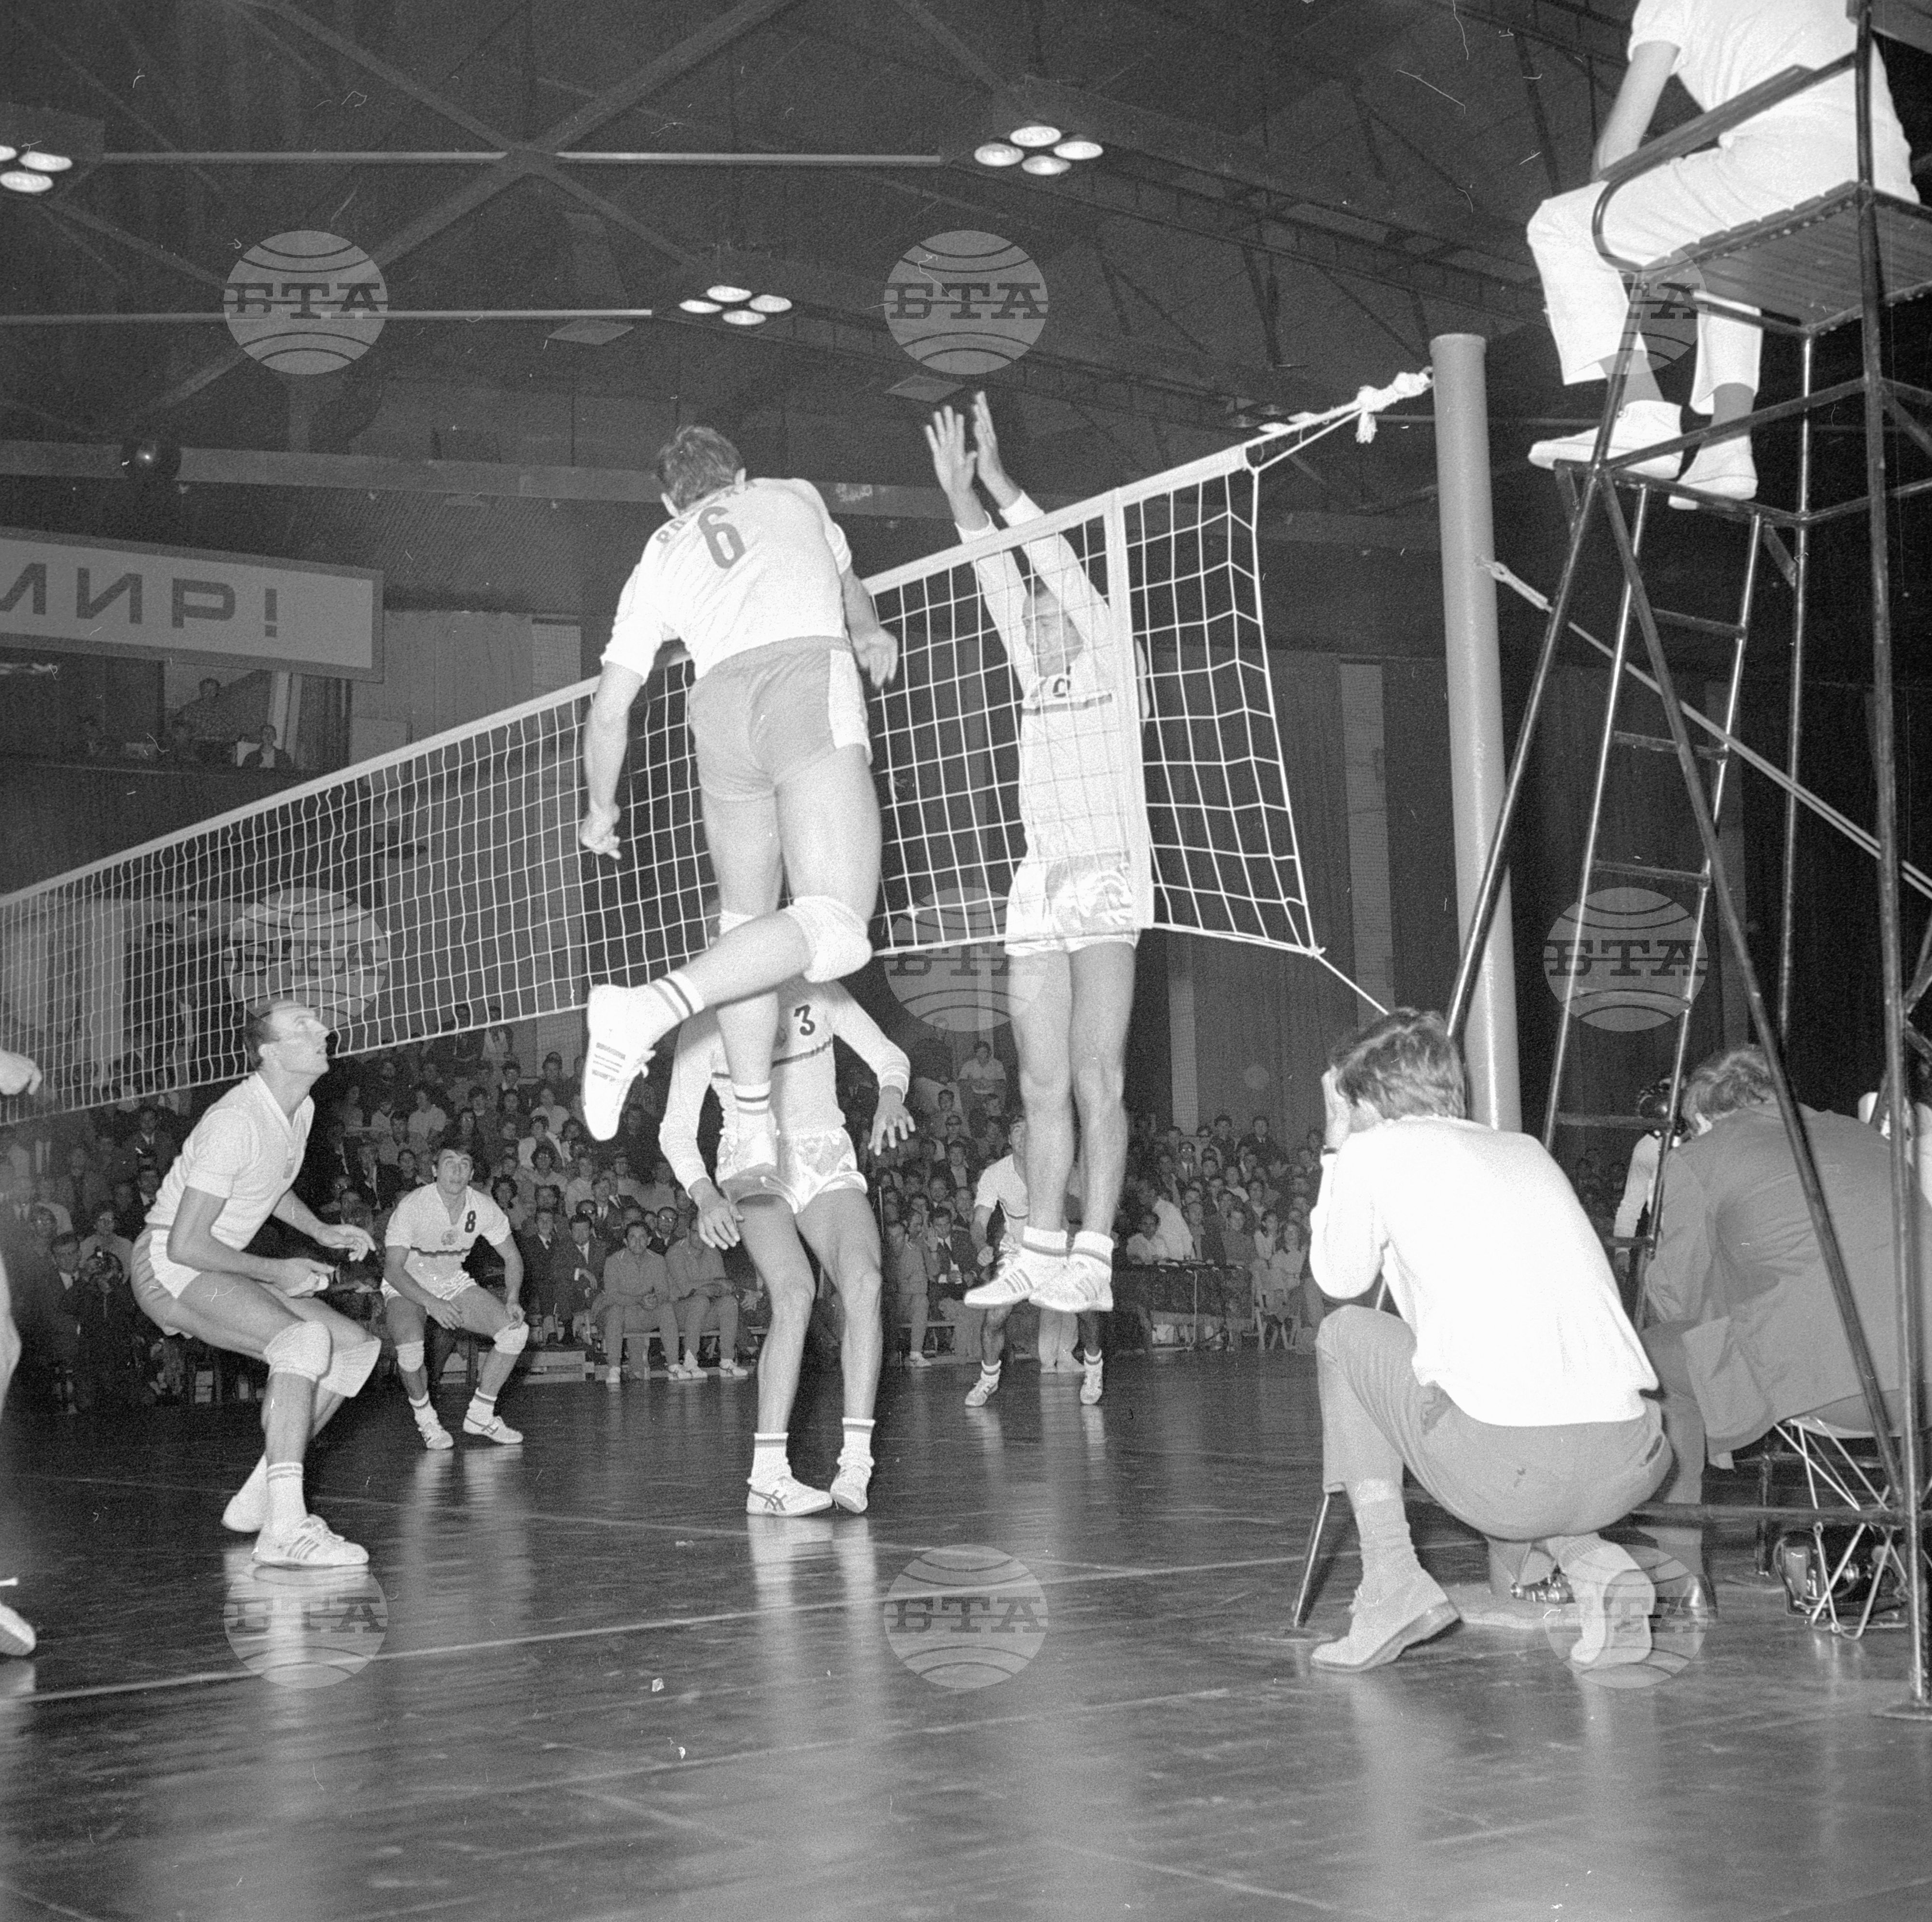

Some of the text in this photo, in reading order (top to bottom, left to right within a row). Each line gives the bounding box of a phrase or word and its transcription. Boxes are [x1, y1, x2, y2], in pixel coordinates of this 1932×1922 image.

[697, 506, 746, 569] 6
[794, 1004, 816, 1036] 3
[464, 1210, 477, 1233] 8
